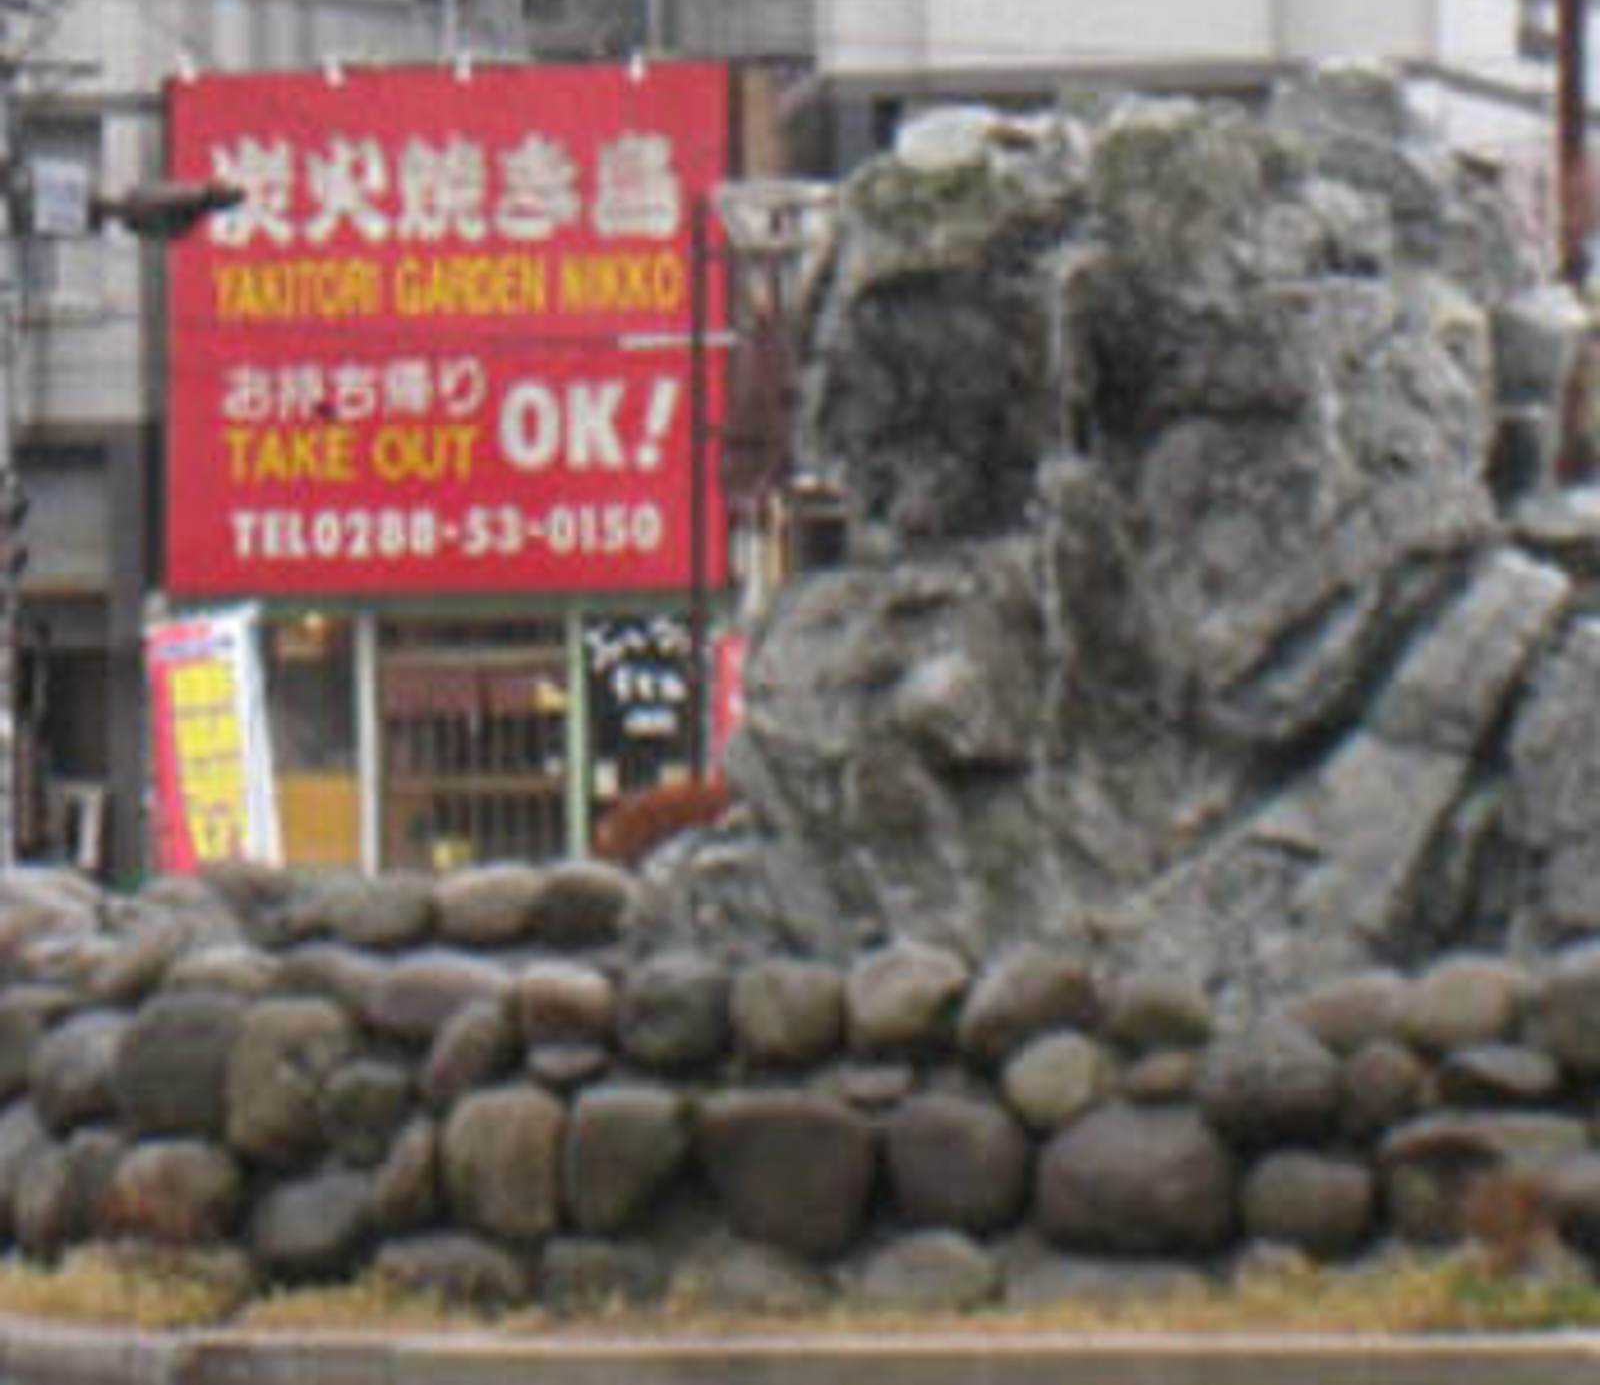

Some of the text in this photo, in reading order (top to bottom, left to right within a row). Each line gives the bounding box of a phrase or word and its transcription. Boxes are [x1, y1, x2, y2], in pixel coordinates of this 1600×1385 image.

[216, 258, 380, 319] YAKITORI
[395, 254, 546, 317] GARDEN
[222, 356, 488, 422] お持ち帰り
[223, 424, 481, 485] TAKE OUT
[500, 378, 679, 471] OK!
